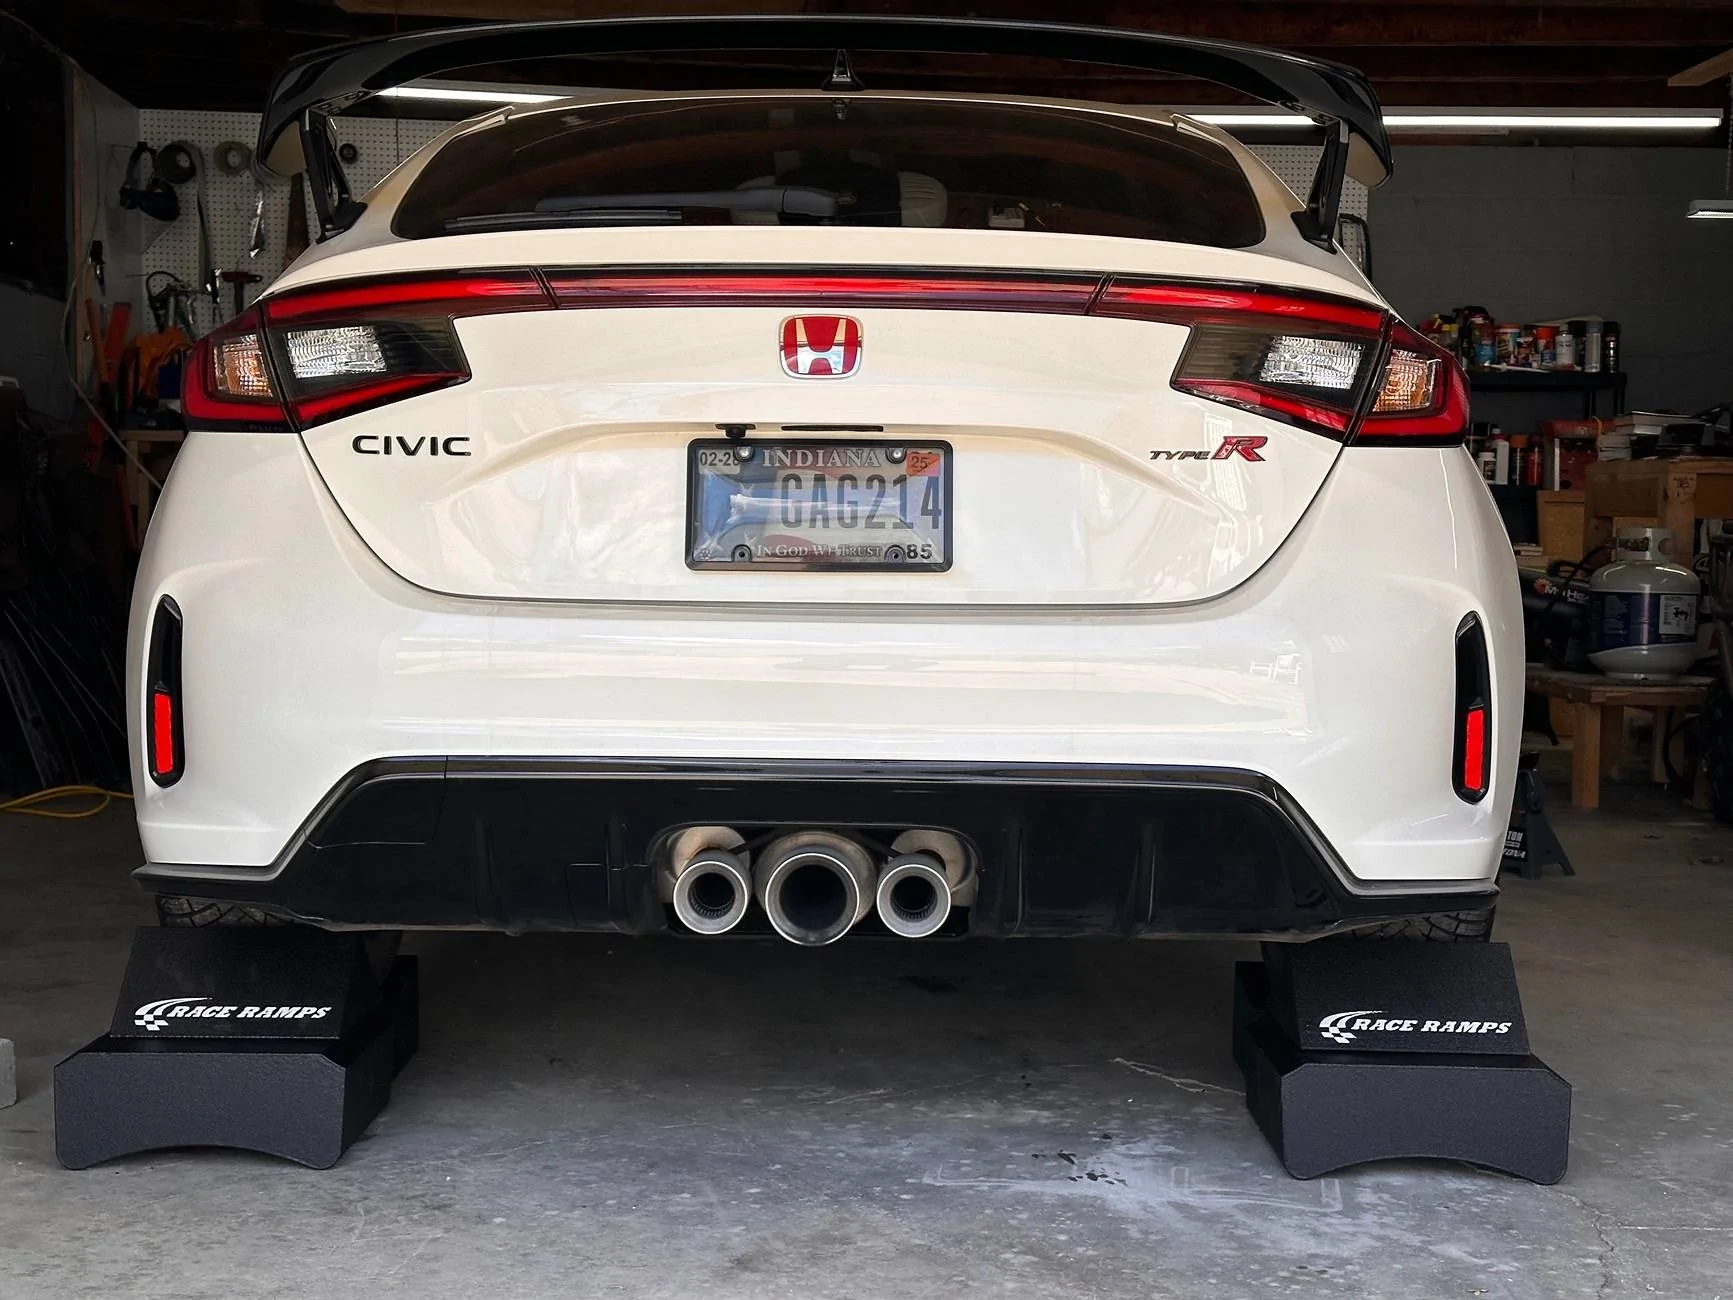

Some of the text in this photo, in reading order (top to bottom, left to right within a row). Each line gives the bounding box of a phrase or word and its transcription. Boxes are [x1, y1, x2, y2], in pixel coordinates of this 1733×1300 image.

[352, 435, 472, 456] CIVIC
[1149, 435, 1269, 463] TYPE R
[762, 448, 881, 468] INDIANA
[910, 455, 929, 470] 25
[757, 543, 773, 557] IN
[775, 543, 809, 557] GOD
[837, 543, 883, 558] TRUST
[906, 543, 934, 560] 85
[167, 1005, 332, 1019] RACE RAMPS
[1351, 1018, 1512, 1034] RACE RAMPS
